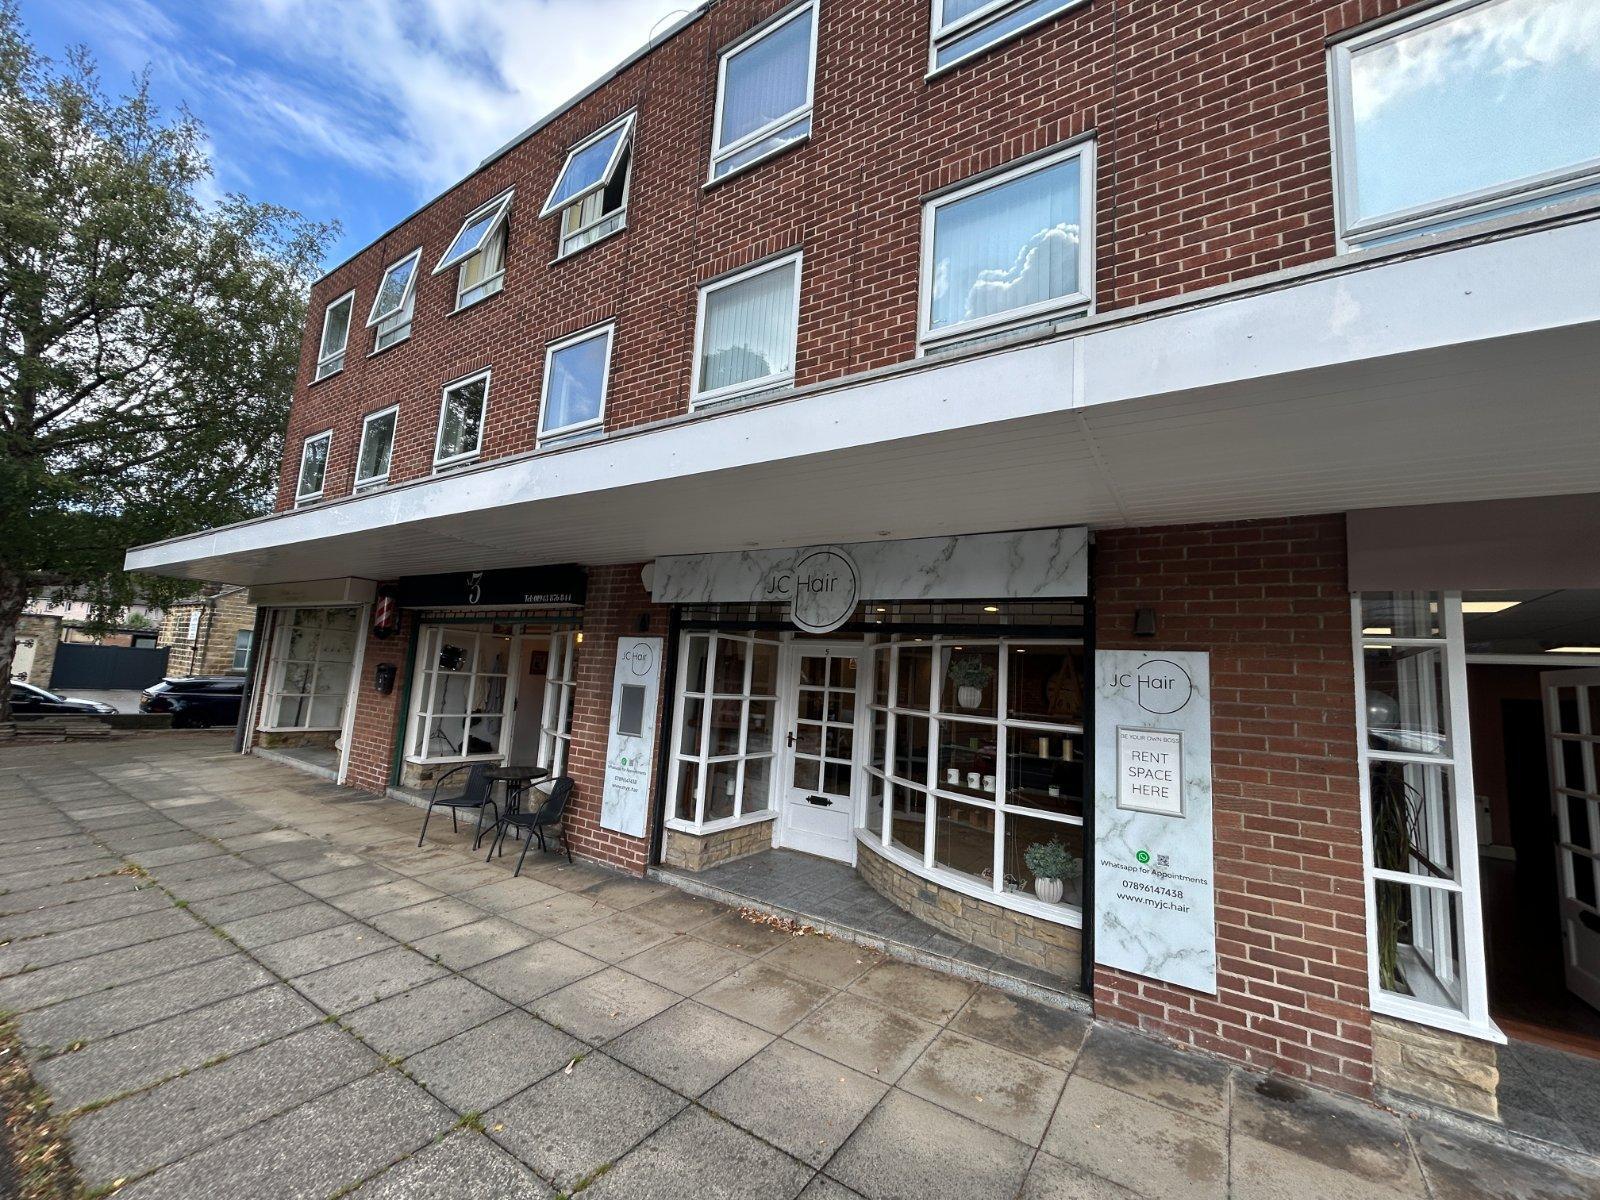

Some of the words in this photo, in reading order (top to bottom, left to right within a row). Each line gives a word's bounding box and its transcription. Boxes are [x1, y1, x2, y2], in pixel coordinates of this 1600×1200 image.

[767, 575, 791, 594] JC
[797, 574, 838, 593] Hair
[1109, 674, 1132, 688] JC
[1138, 674, 1176, 690] Hair
[1131, 750, 1169, 764] RENT
[1128, 766, 1172, 782] SPACE
[1132, 783, 1169, 799] HERE
[1100, 859, 1138, 873] Whatsapp
[1139, 865, 1149, 874] for
[1151, 869, 1208, 886] Appointments
[1122, 880, 1184, 899] 07896147438
[1116, 892, 1190, 914] www.myjc.hair
